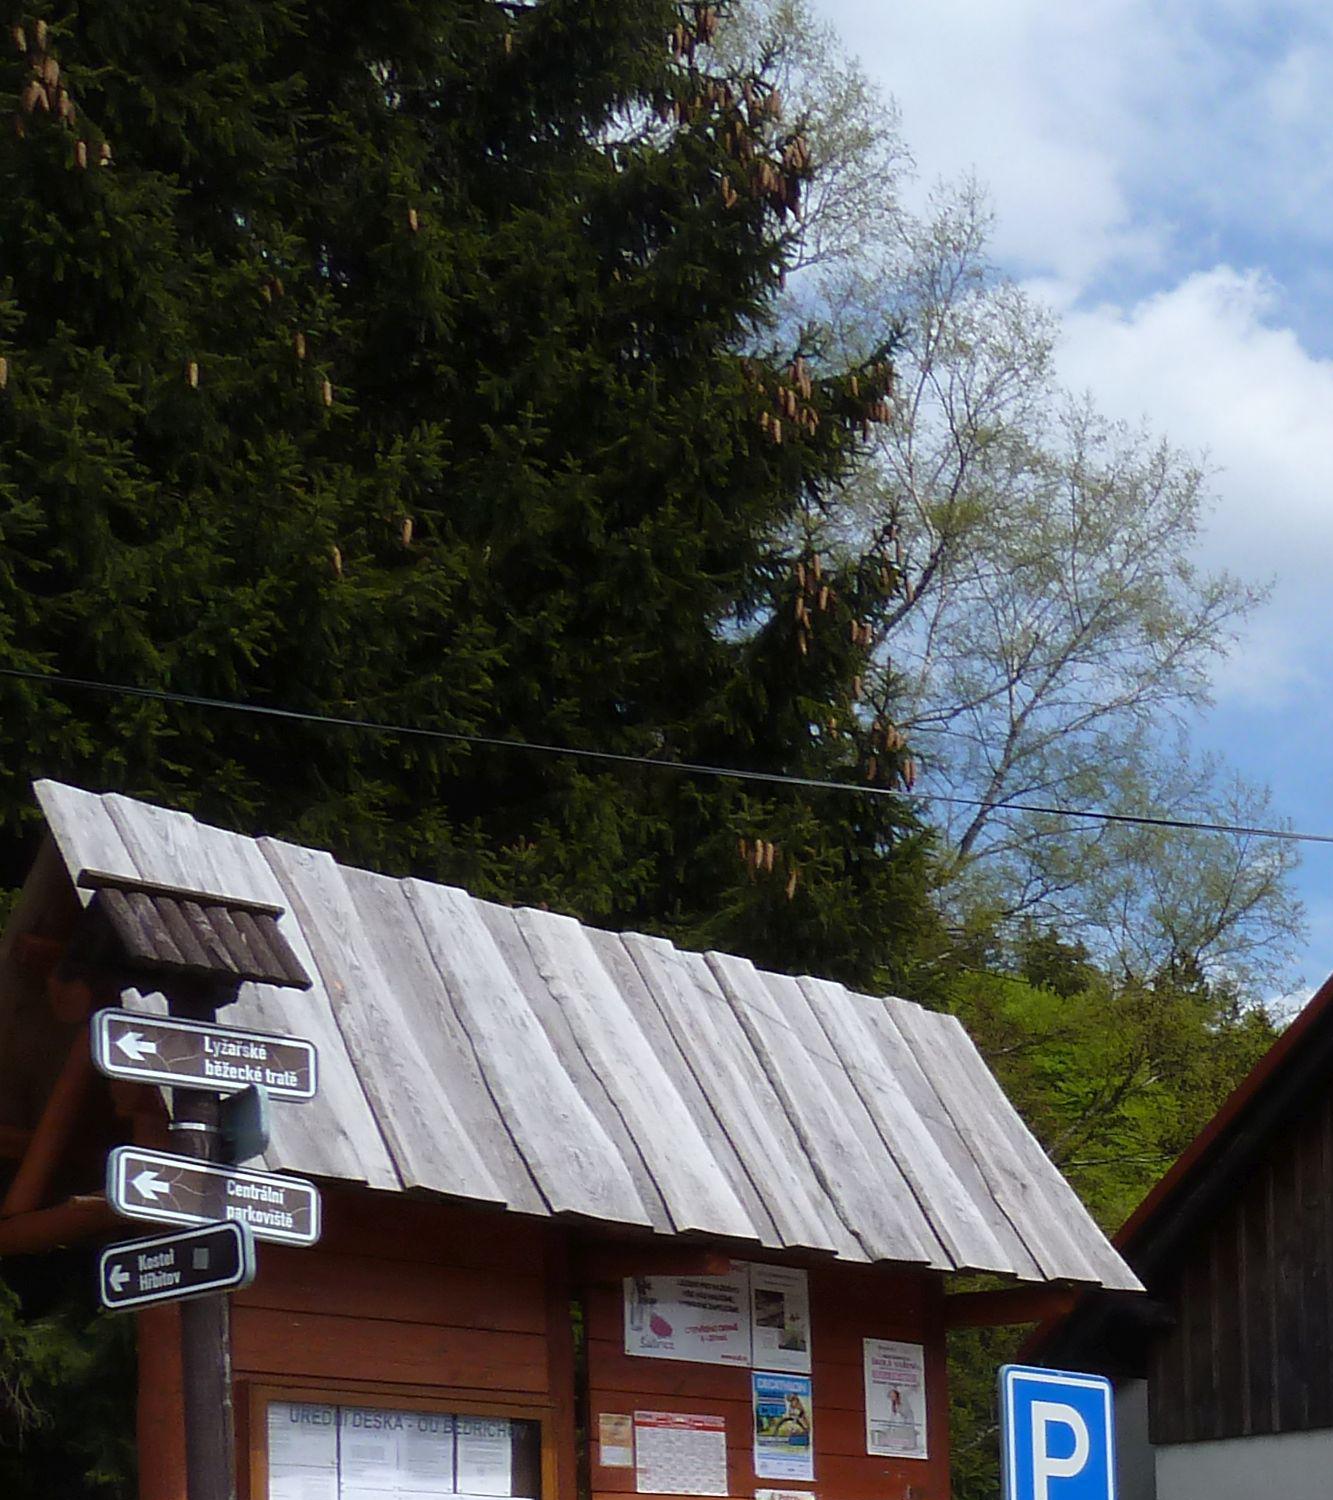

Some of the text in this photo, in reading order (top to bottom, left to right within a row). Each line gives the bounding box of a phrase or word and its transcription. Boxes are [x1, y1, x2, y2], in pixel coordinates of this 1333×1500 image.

[204, 1036, 267, 1060] Lyžařské
[205, 1059, 298, 1087] běžecké tratě
[227, 1180, 284, 1204] Centrální
[227, 1205, 293, 1228] parkoviště
